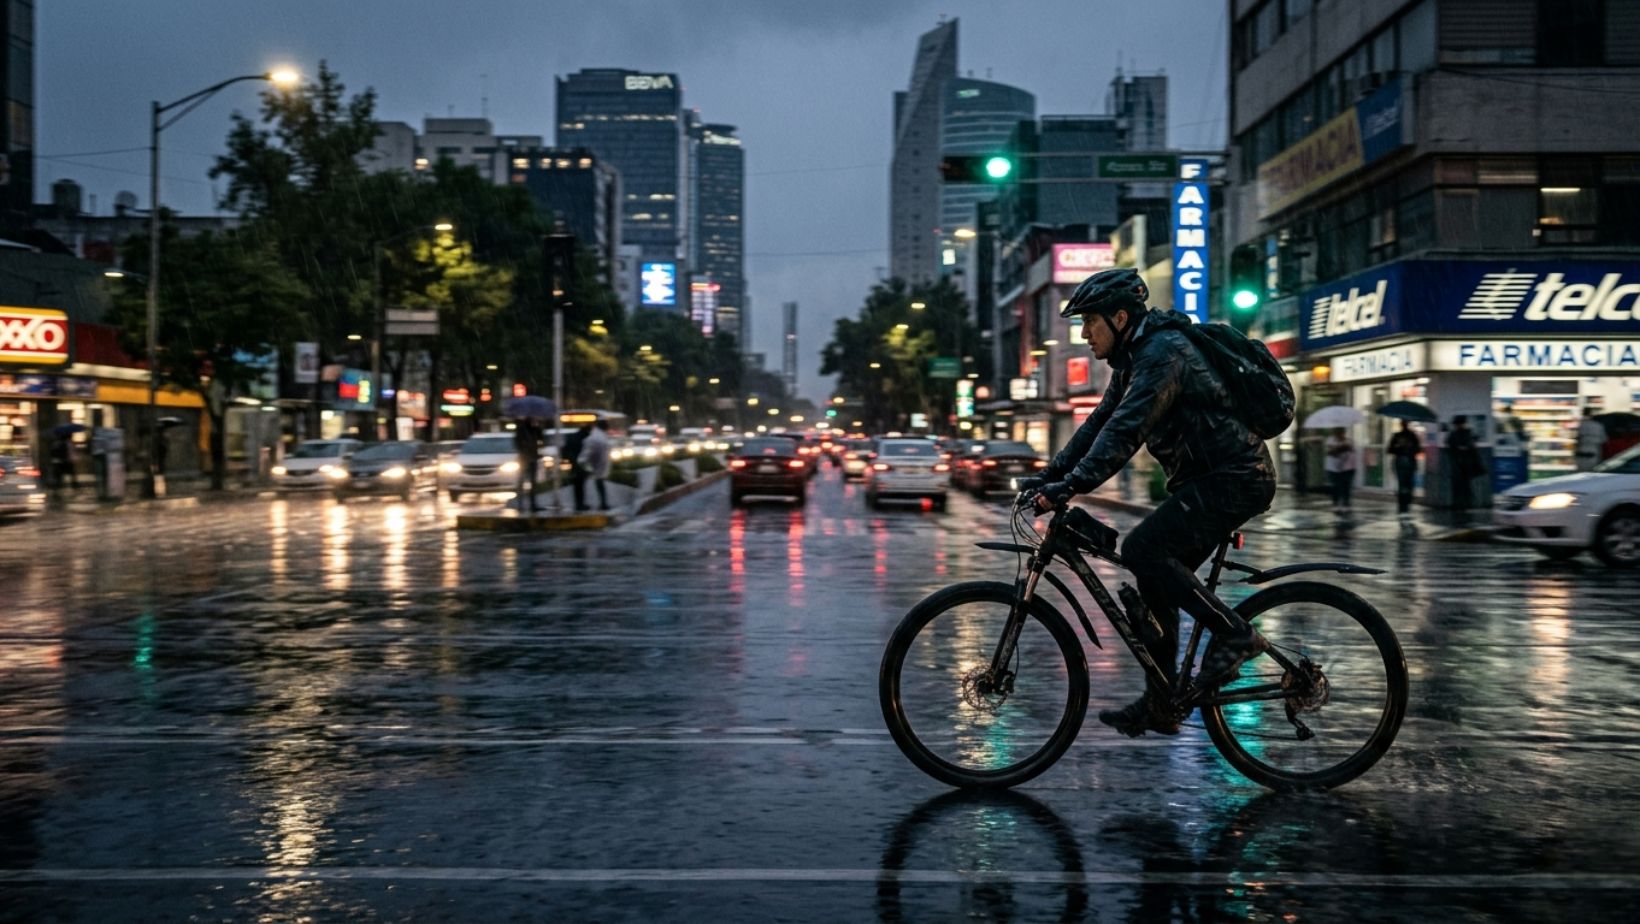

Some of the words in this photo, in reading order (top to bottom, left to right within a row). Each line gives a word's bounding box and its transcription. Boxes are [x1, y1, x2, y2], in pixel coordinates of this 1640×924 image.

[1325, 279, 1388, 337] telcel
[1523, 272, 1640, 321] telc
[0, 319, 65, 351] XXO
[1343, 348, 1413, 377] FARMACIA
[1458, 344, 1639, 367] FARMACIA
